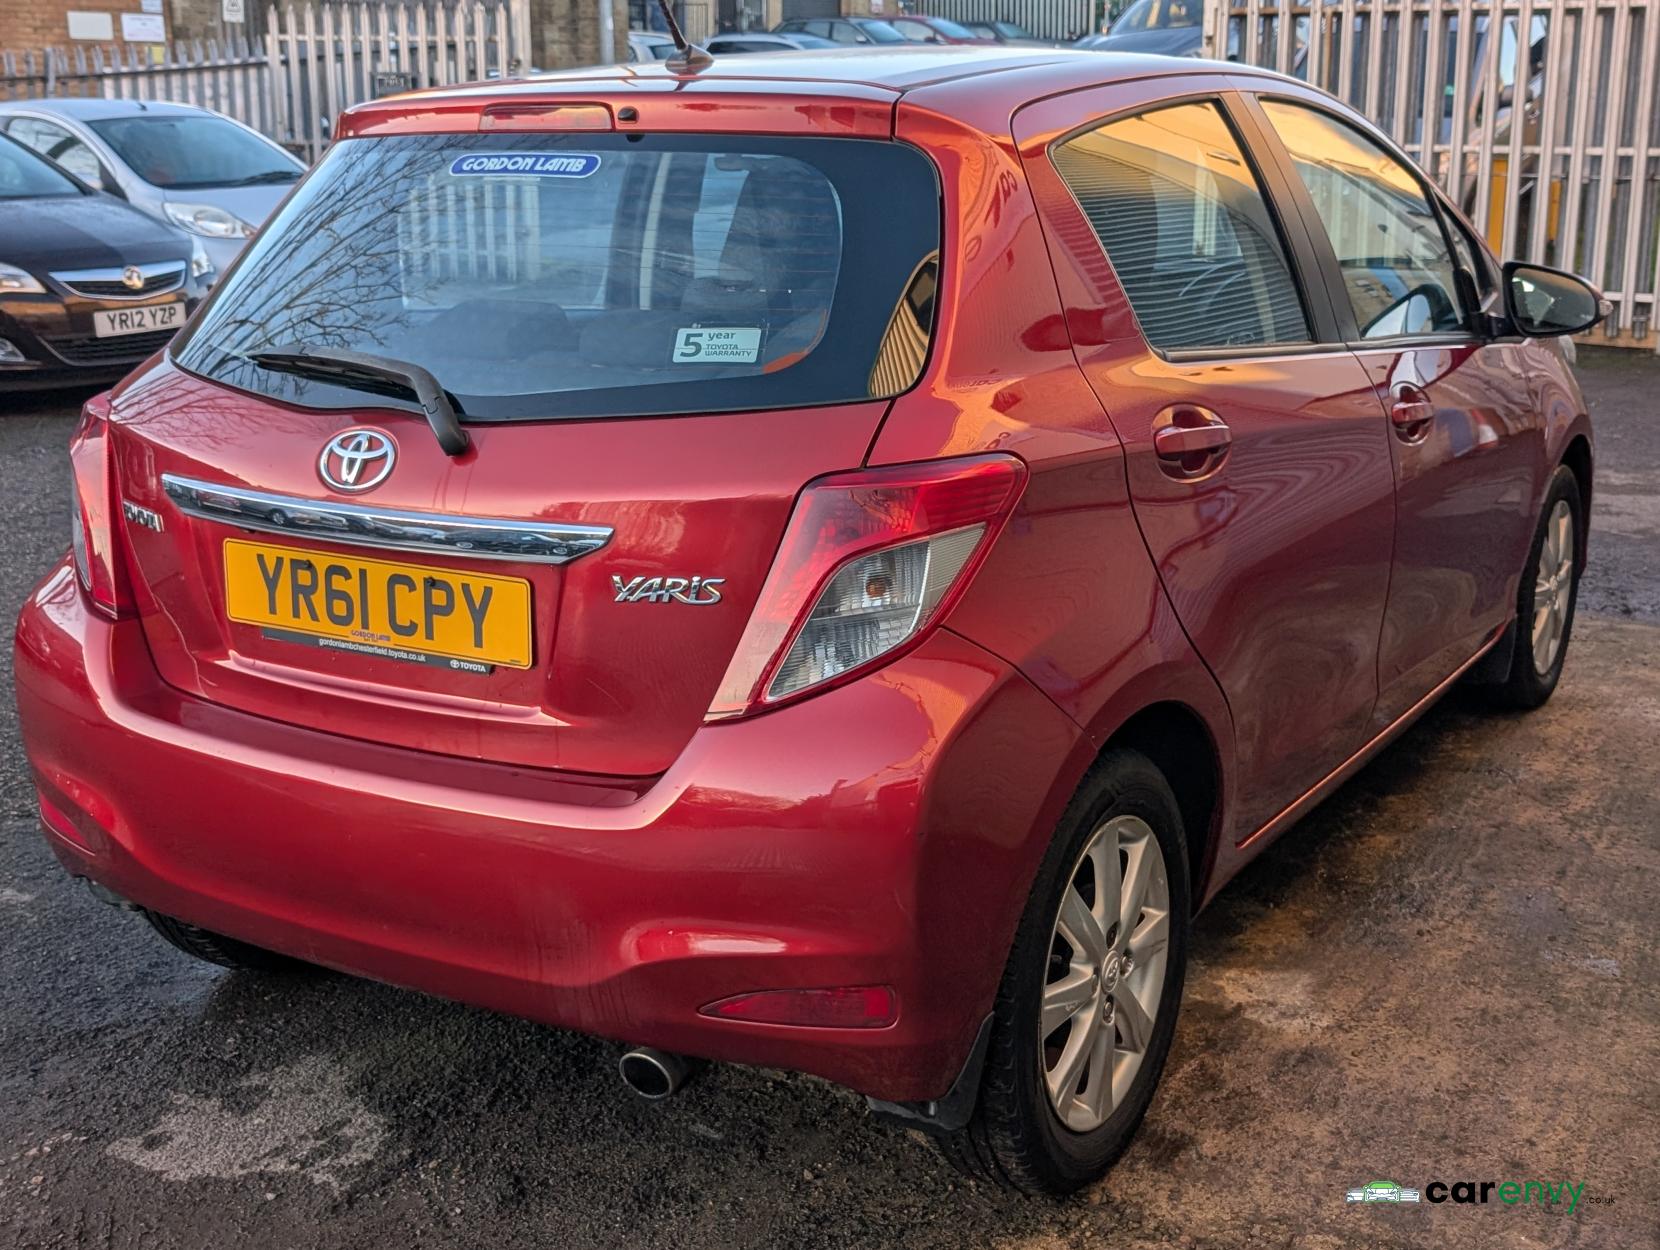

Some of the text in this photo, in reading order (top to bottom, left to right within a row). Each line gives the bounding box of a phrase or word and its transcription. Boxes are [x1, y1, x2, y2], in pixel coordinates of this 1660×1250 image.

[462, 157, 587, 172] GORDON LAMB
[107, 306, 176, 331] YR12 YZP
[680, 332, 737, 358] 5 year
[256, 553, 494, 649] YR61 CPY
[460, 661, 487, 673] TOYOTA
